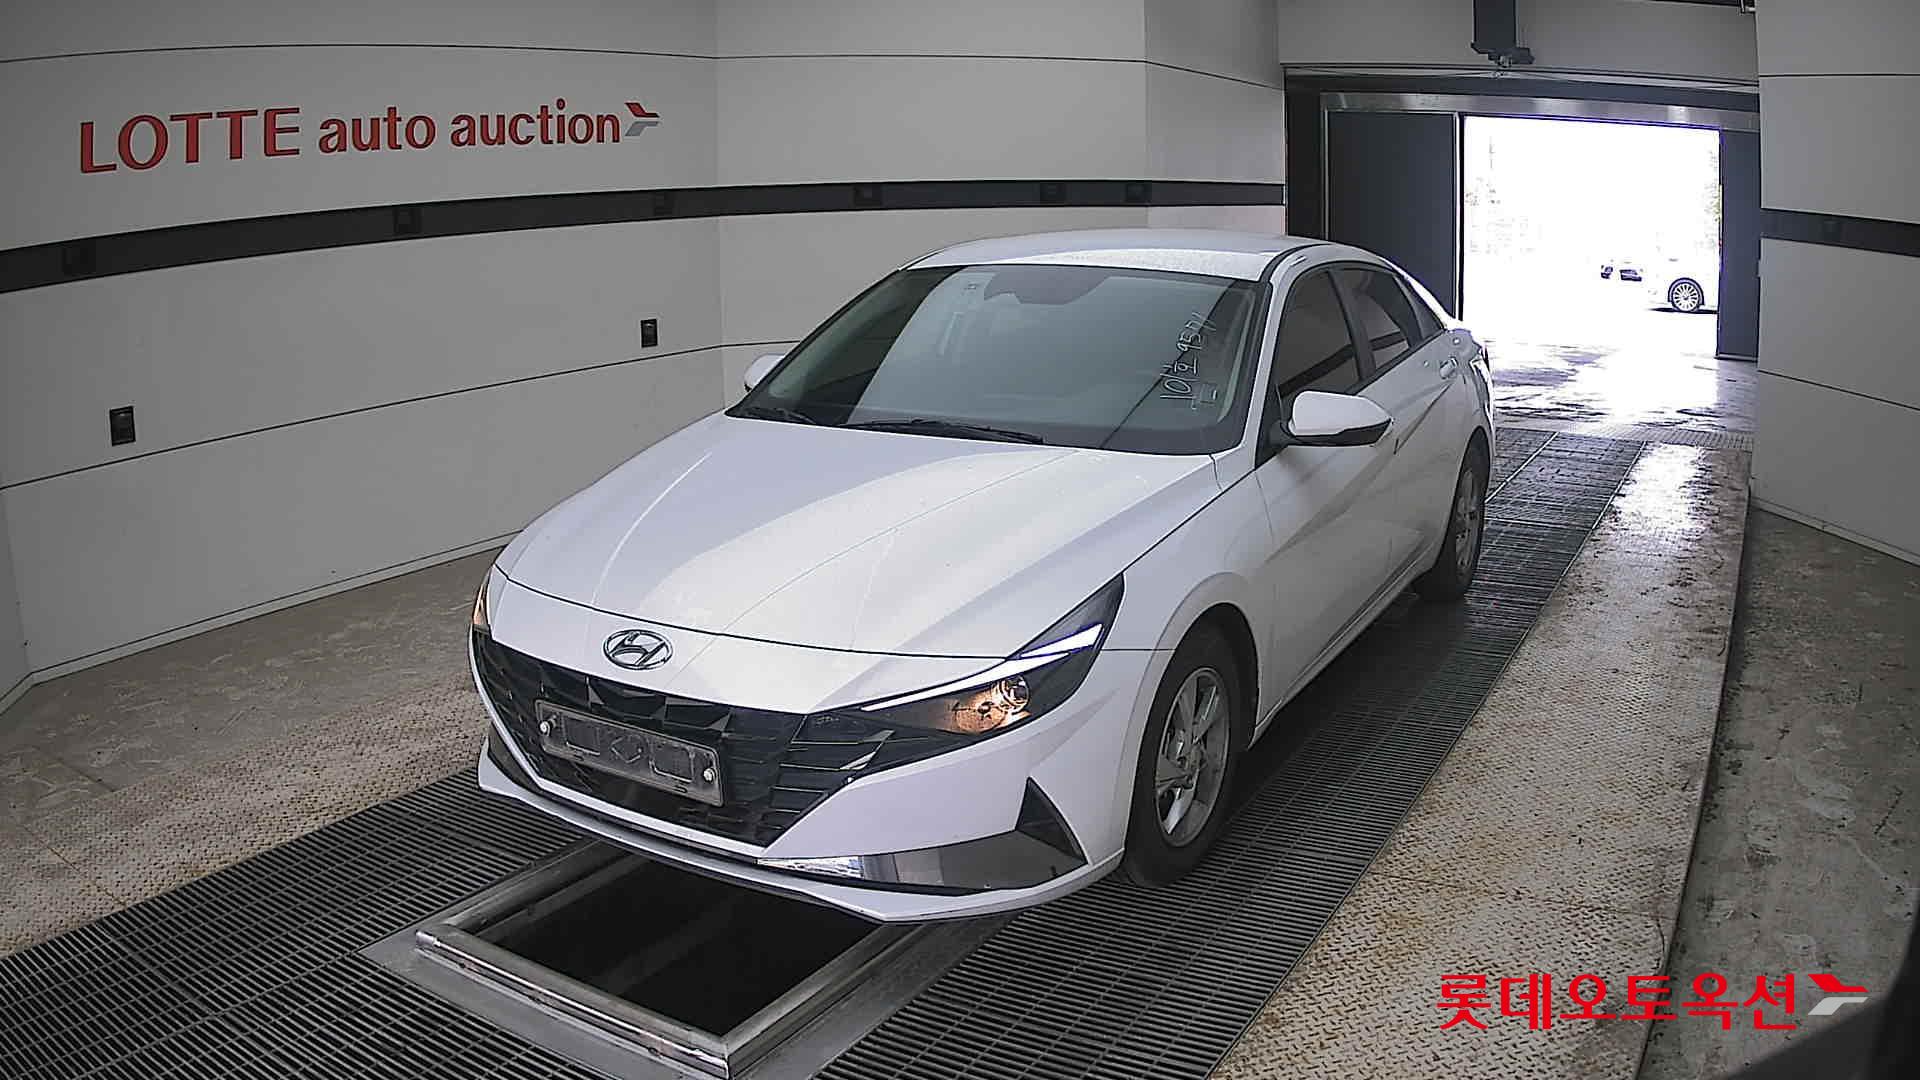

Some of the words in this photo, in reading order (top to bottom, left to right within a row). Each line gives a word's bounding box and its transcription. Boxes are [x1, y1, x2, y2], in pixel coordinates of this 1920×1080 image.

[80, 107, 300, 173] LOTTE
[319, 106, 436, 153] auto
[450, 99, 620, 146] auction
